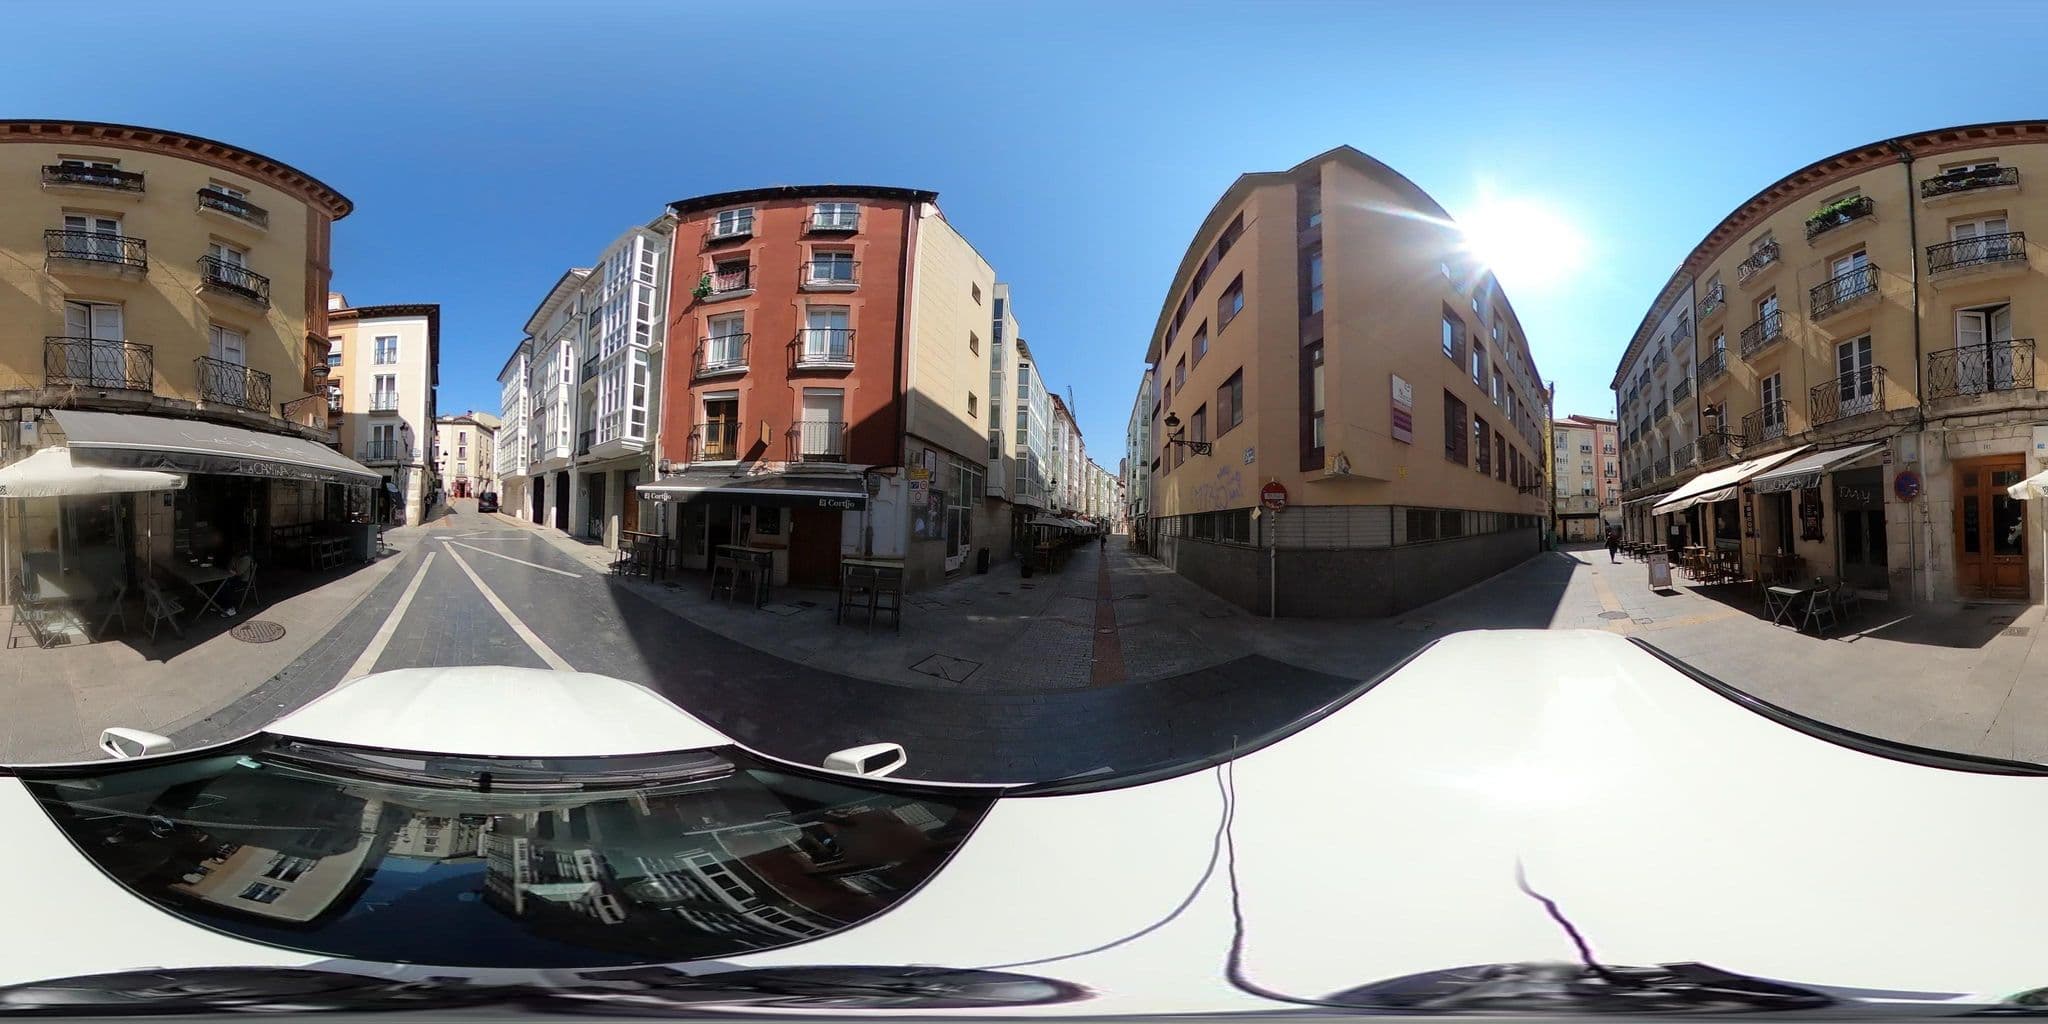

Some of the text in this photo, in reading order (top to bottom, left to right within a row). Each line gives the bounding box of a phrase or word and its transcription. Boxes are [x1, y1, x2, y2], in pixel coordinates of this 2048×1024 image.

[644, 491, 672, 502] El Cortijo
[819, 498, 856, 509] El Cortijo
